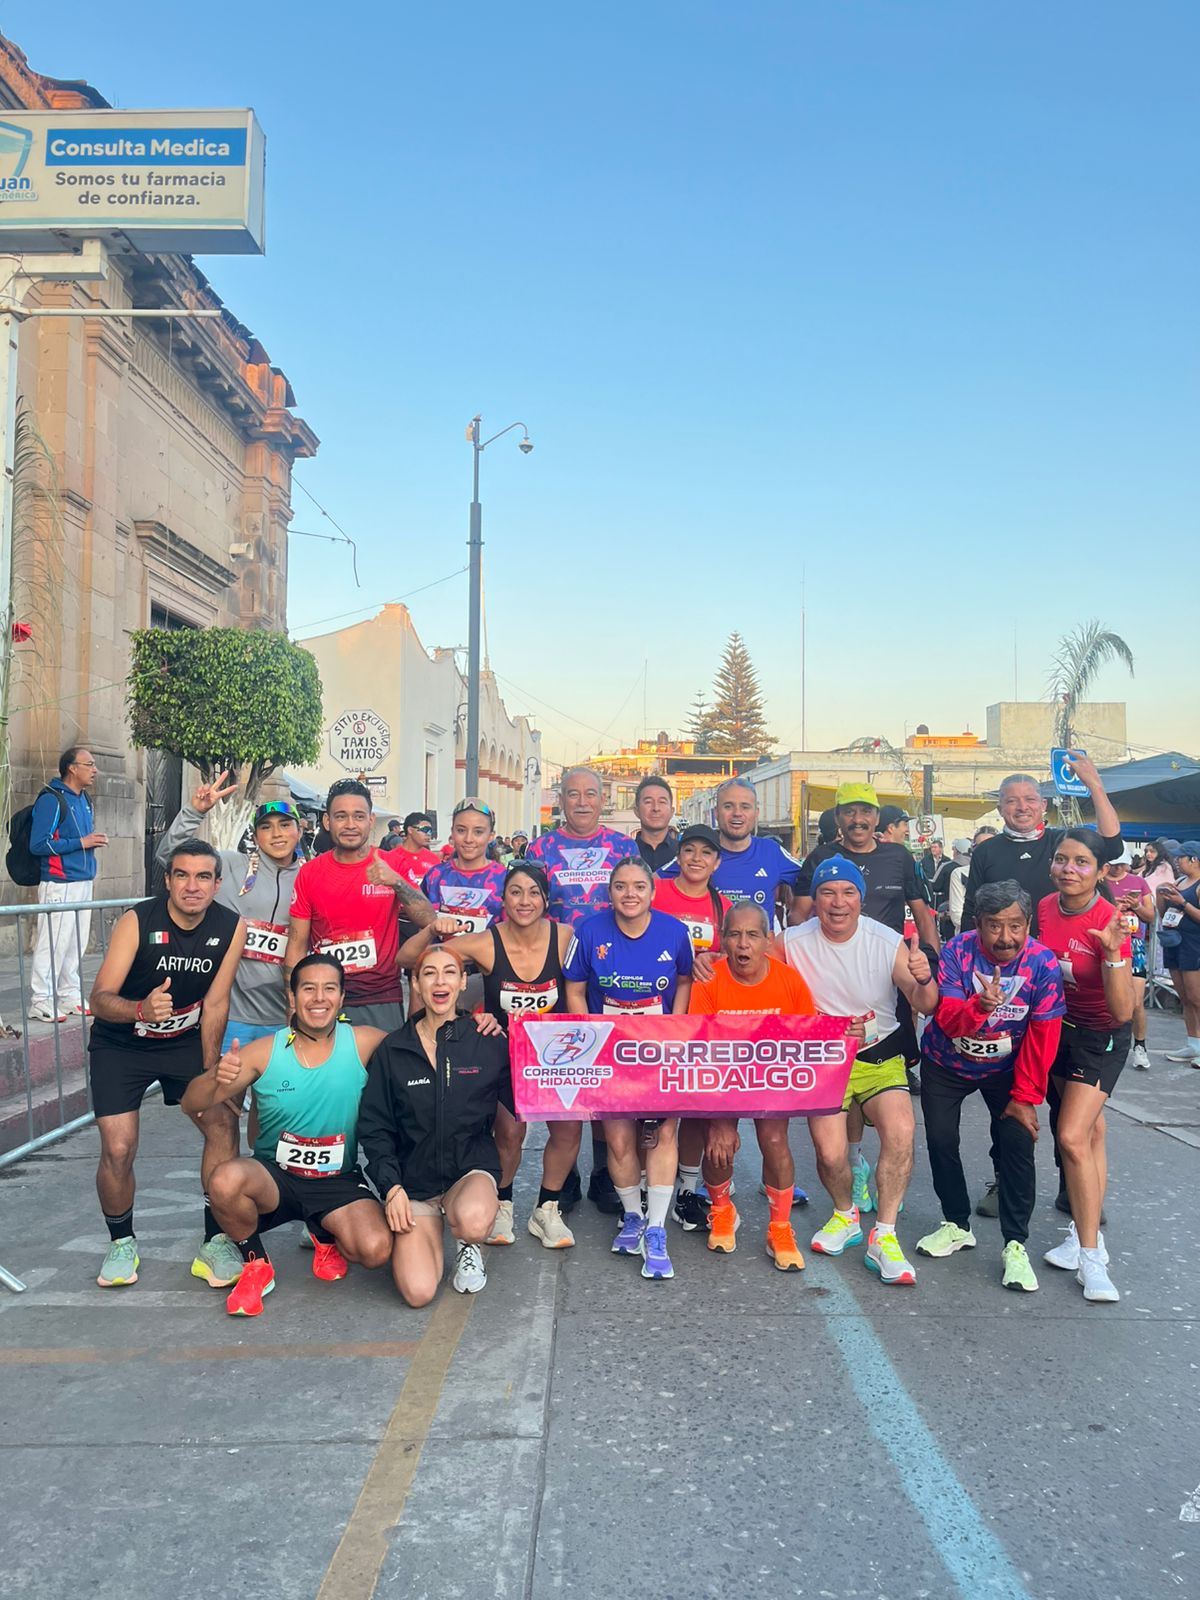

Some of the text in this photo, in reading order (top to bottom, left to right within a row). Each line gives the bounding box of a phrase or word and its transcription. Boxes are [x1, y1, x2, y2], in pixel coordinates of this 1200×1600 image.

[50, 138, 230, 157] Consulta Medica
[55, 171, 226, 186] Somos tu farmacia
[78, 190, 200, 206] de confianza.
[334, 712, 358, 736] SITIO
[342, 736, 378, 748] TAXIS
[340, 747, 383, 760] MIXTOS
[246, 932, 279, 951] 876
[511, 995, 548, 1010] 526
[615, 1041, 845, 1064] CORREDORES
[960, 1037, 999, 1055] 528
[525, 1067, 611, 1077] CORREDORES
[661, 1067, 815, 1090] HIDALGO
[540, 1077, 600, 1086] HIDALGO
[288, 1149, 331, 1165] 285
